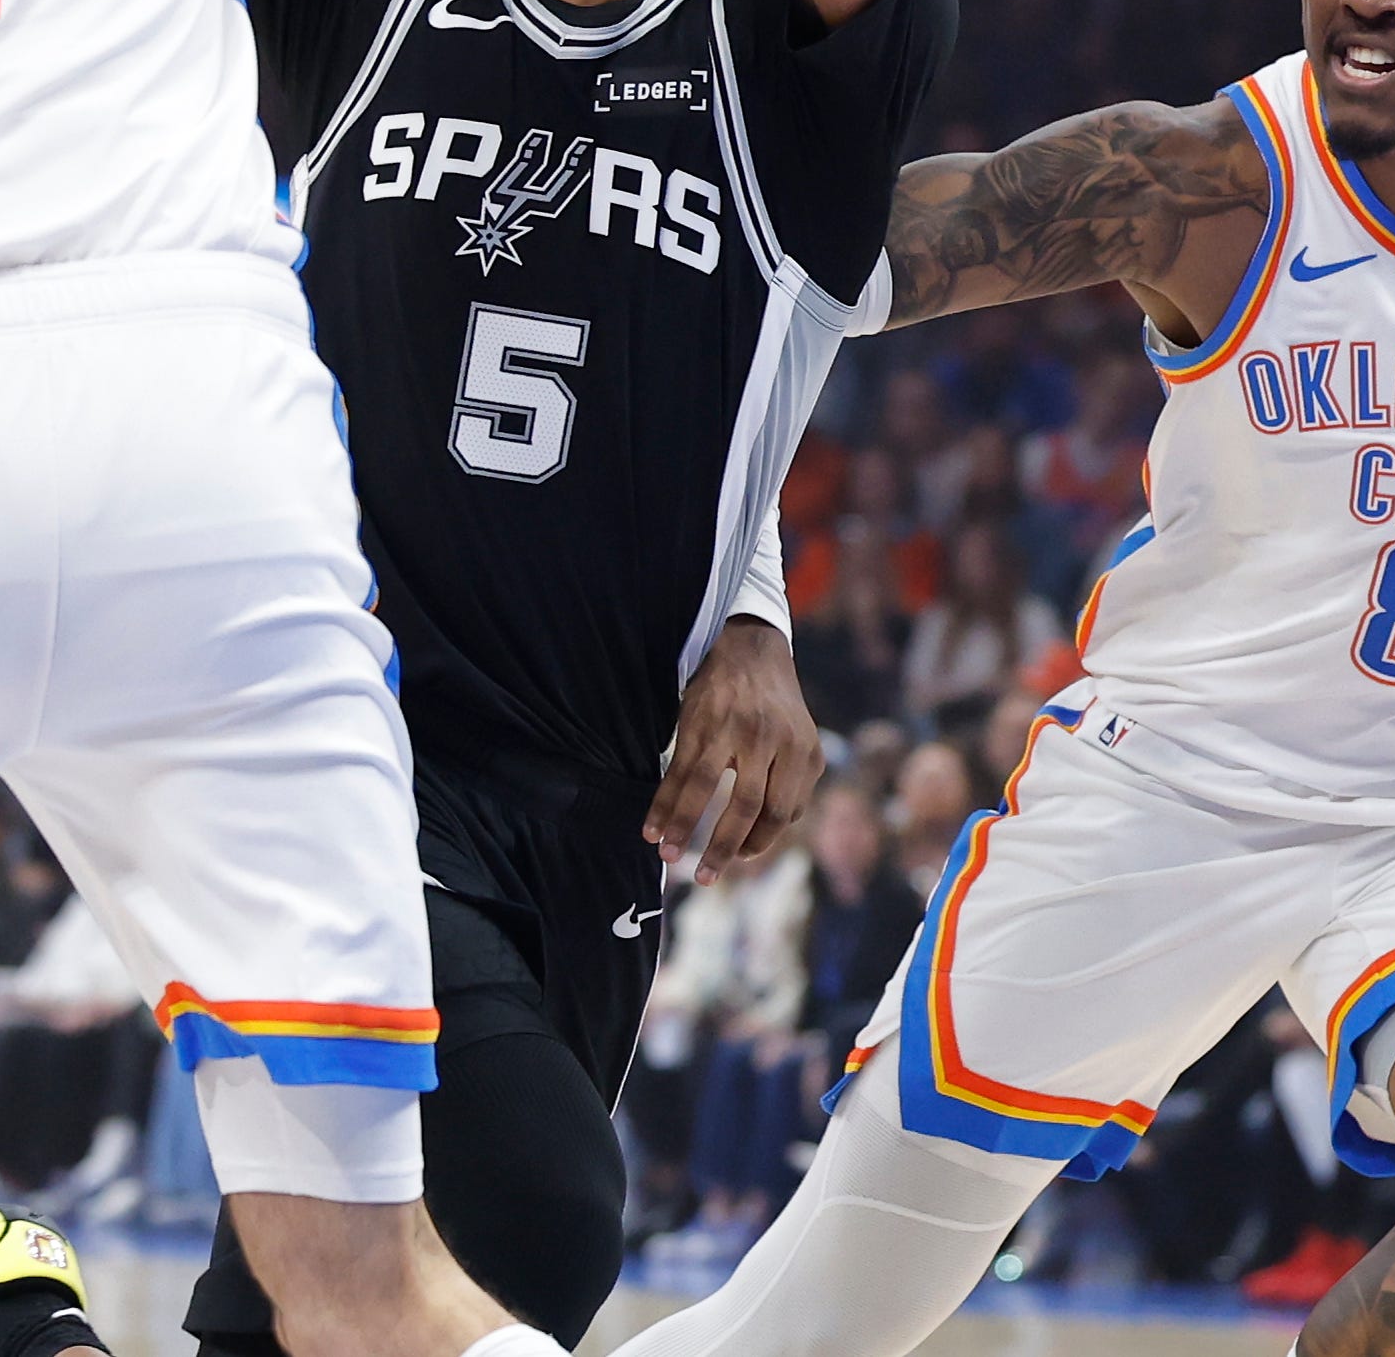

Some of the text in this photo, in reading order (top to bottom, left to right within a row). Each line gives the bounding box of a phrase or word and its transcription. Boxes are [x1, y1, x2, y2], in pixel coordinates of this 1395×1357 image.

[609, 81, 693, 101] LEDGER
[362, 111, 722, 278] SPURS
[447, 301, 591, 485] 5
